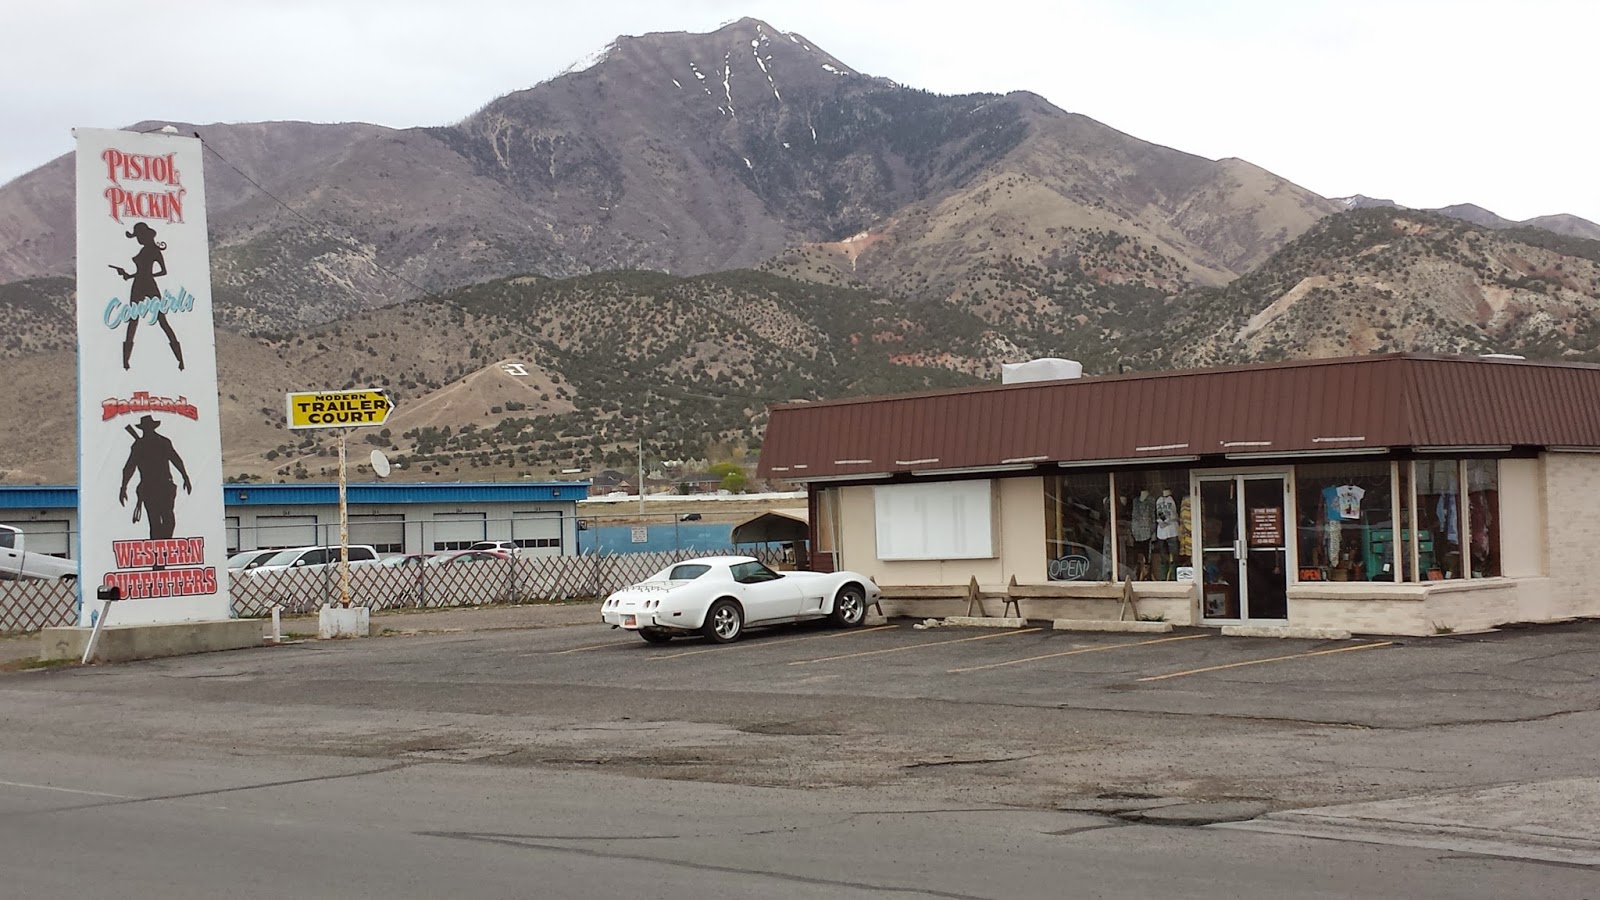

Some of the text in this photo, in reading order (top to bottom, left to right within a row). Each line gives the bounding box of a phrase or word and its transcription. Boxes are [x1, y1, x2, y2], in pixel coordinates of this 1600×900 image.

[101, 148, 180, 186] PISTOL
[104, 187, 186, 224] PACKIN
[104, 286, 195, 329] Cowgirls
[102, 391, 199, 421] Badlands
[298, 400, 386, 412] TRAILER
[308, 411, 376, 423] COURT
[113, 537, 204, 569] WESTERN
[1050, 560, 1086, 576] OPEN
